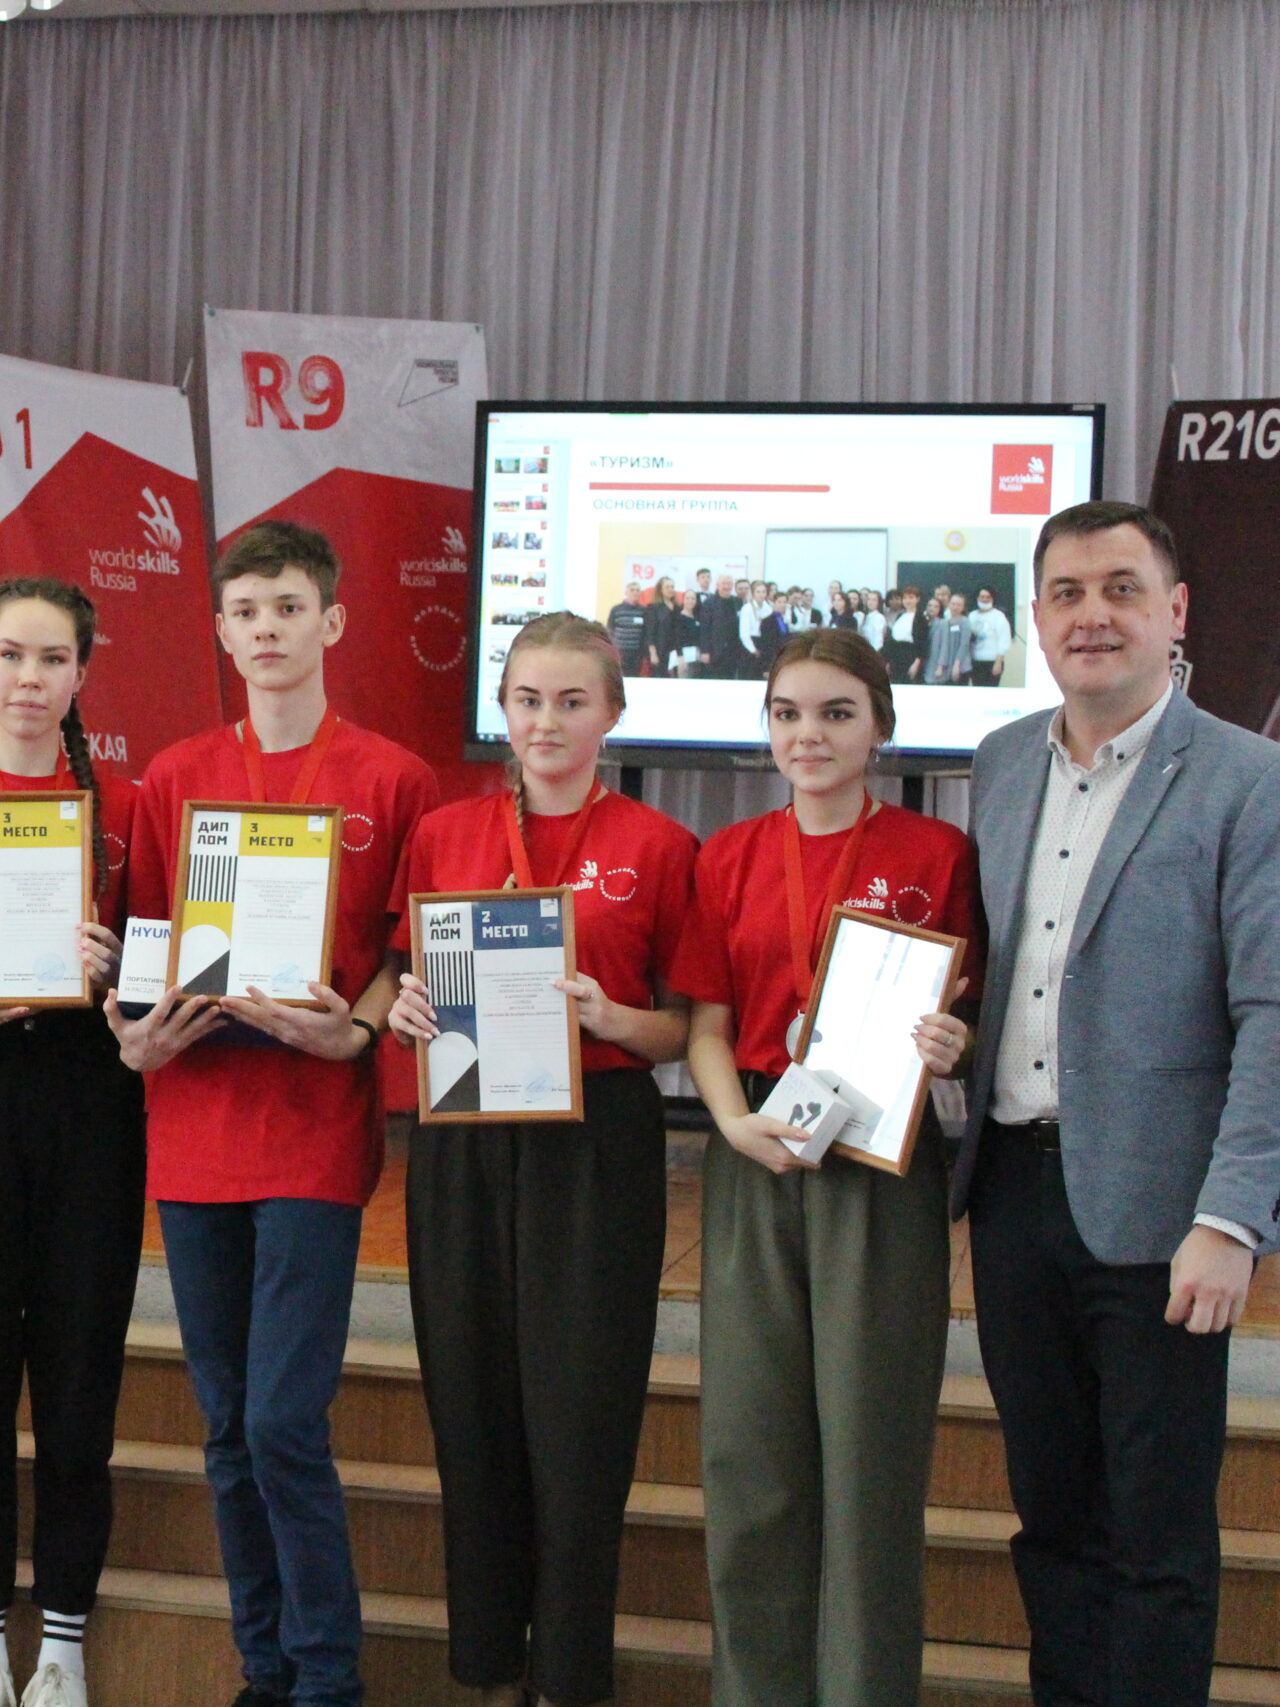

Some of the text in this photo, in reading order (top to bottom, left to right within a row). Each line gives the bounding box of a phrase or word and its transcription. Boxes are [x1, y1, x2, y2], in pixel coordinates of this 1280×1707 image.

[241, 351, 345, 431] R9
[1177, 408, 1280, 462] R21G
[593, 498, 738, 512] ОСНОВНАЯ ГРУППА
[89, 547, 181, 575] worldskills
[400, 557, 468, 573] worldskills
[90, 566, 137, 591] Russia
[400, 571, 437, 587] Russia
[3, 813, 11, 823] 3
[3, 826, 48, 837] МЕСТО
[198, 821, 229, 833] ДИП
[250, 823, 258, 833] 3
[197, 834, 227, 846] ЛОМ
[249, 836, 294, 848] МЕСТО
[429, 912, 461, 928] ДИП
[481, 911, 491, 923] 2
[131, 926, 172, 939] HYUN
[430, 928, 461, 941] ЛОМ
[482, 924, 529, 939] МЕСТО
